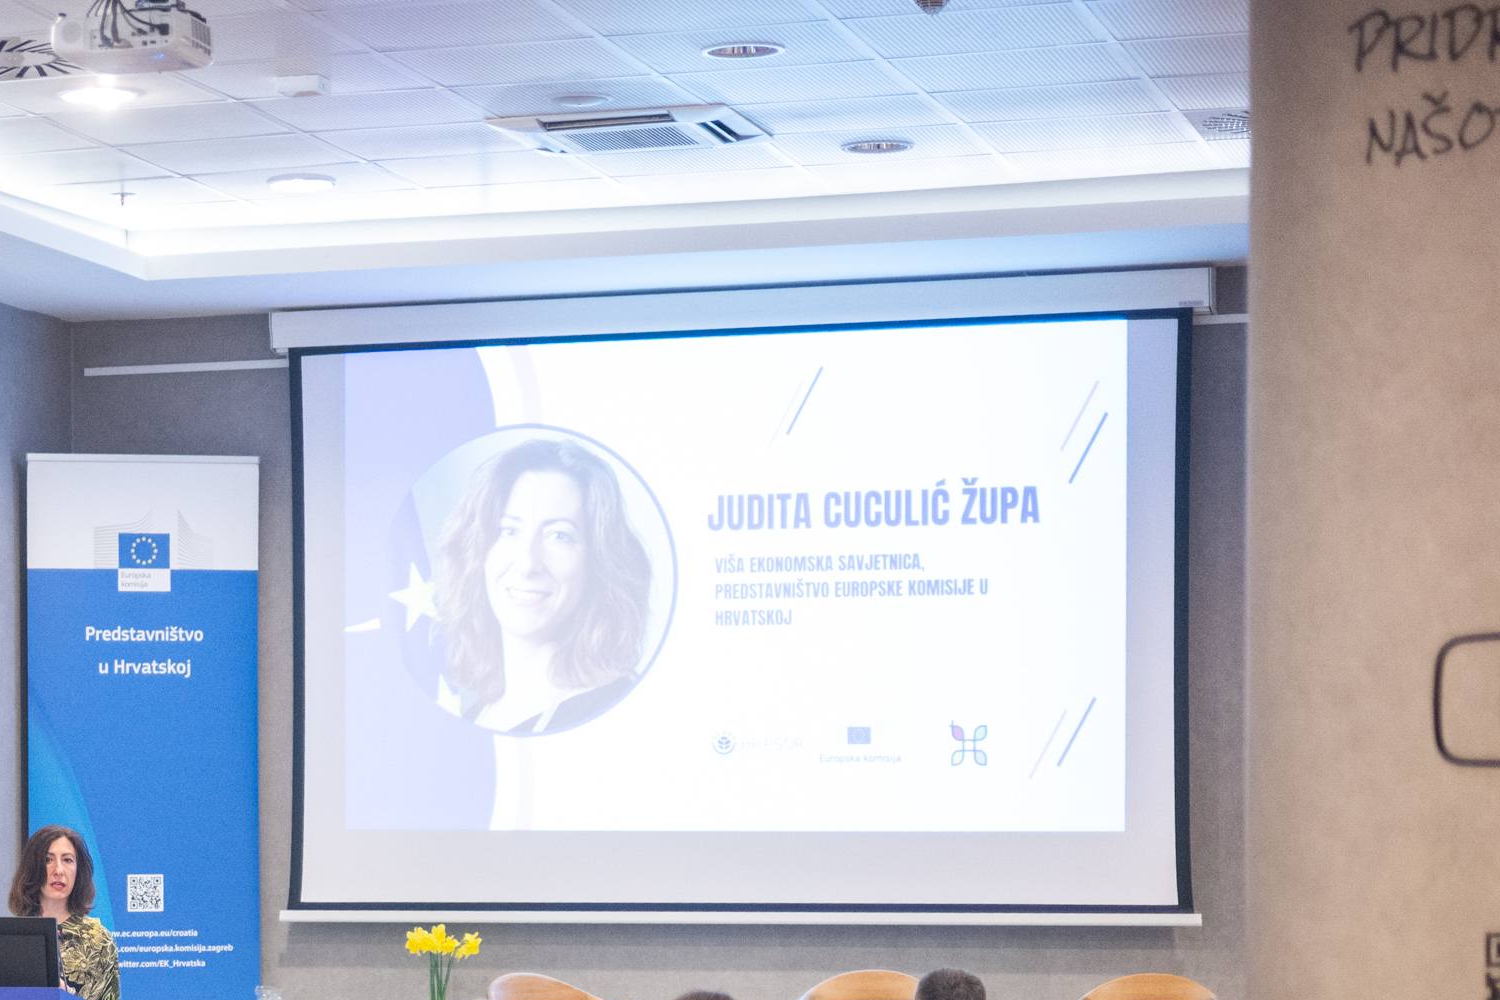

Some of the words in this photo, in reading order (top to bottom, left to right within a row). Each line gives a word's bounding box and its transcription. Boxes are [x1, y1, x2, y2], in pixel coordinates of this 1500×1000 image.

[1366, 91, 1500, 166] NAŠO
[707, 492, 812, 531] JUDITA
[823, 479, 950, 528] CUCULIĆ
[961, 477, 1040, 525] ŽUPA
[715, 552, 745, 574] VIŠA
[750, 554, 833, 573] EKONOMSKA
[838, 553, 925, 573] SAVJETNICA,
[715, 577, 830, 600] PREDSTAVNIŠTVO
[834, 579, 903, 598] EUROPSKE
[908, 578, 975, 597] KOMISIJE
[979, 578, 989, 595] U
[715, 608, 793, 626] HRVATSKOJ
[85, 626, 204, 642] Predstavništvo
[99, 663, 109, 674] u
[113, 659, 192, 678] Hrvatskoj
[117, 944, 234, 953] .com/europska.komisija.zagreb
[118, 960, 206, 968] witter.com/EK_Hrvatska
